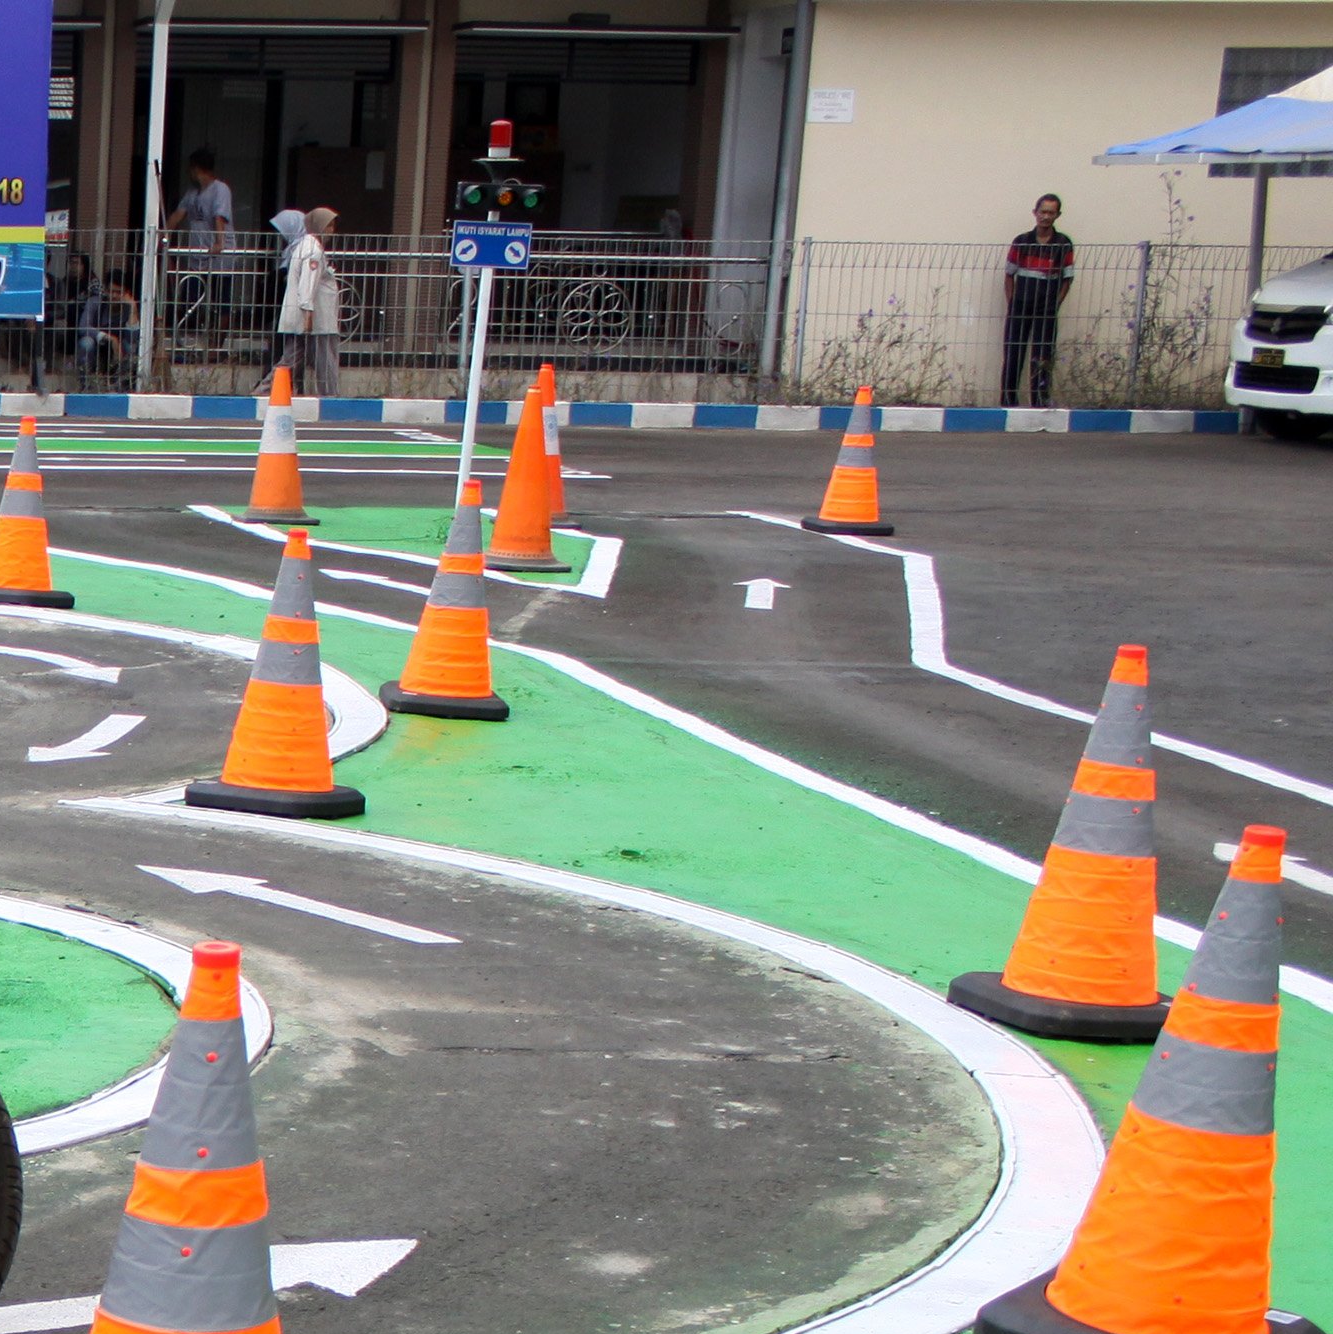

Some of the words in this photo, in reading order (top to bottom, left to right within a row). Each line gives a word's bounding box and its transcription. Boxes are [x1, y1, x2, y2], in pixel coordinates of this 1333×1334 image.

[457, 226, 476, 235] IKUTI
[477, 226, 505, 236] ISYARAT
[507, 228, 530, 237] LAMPU
